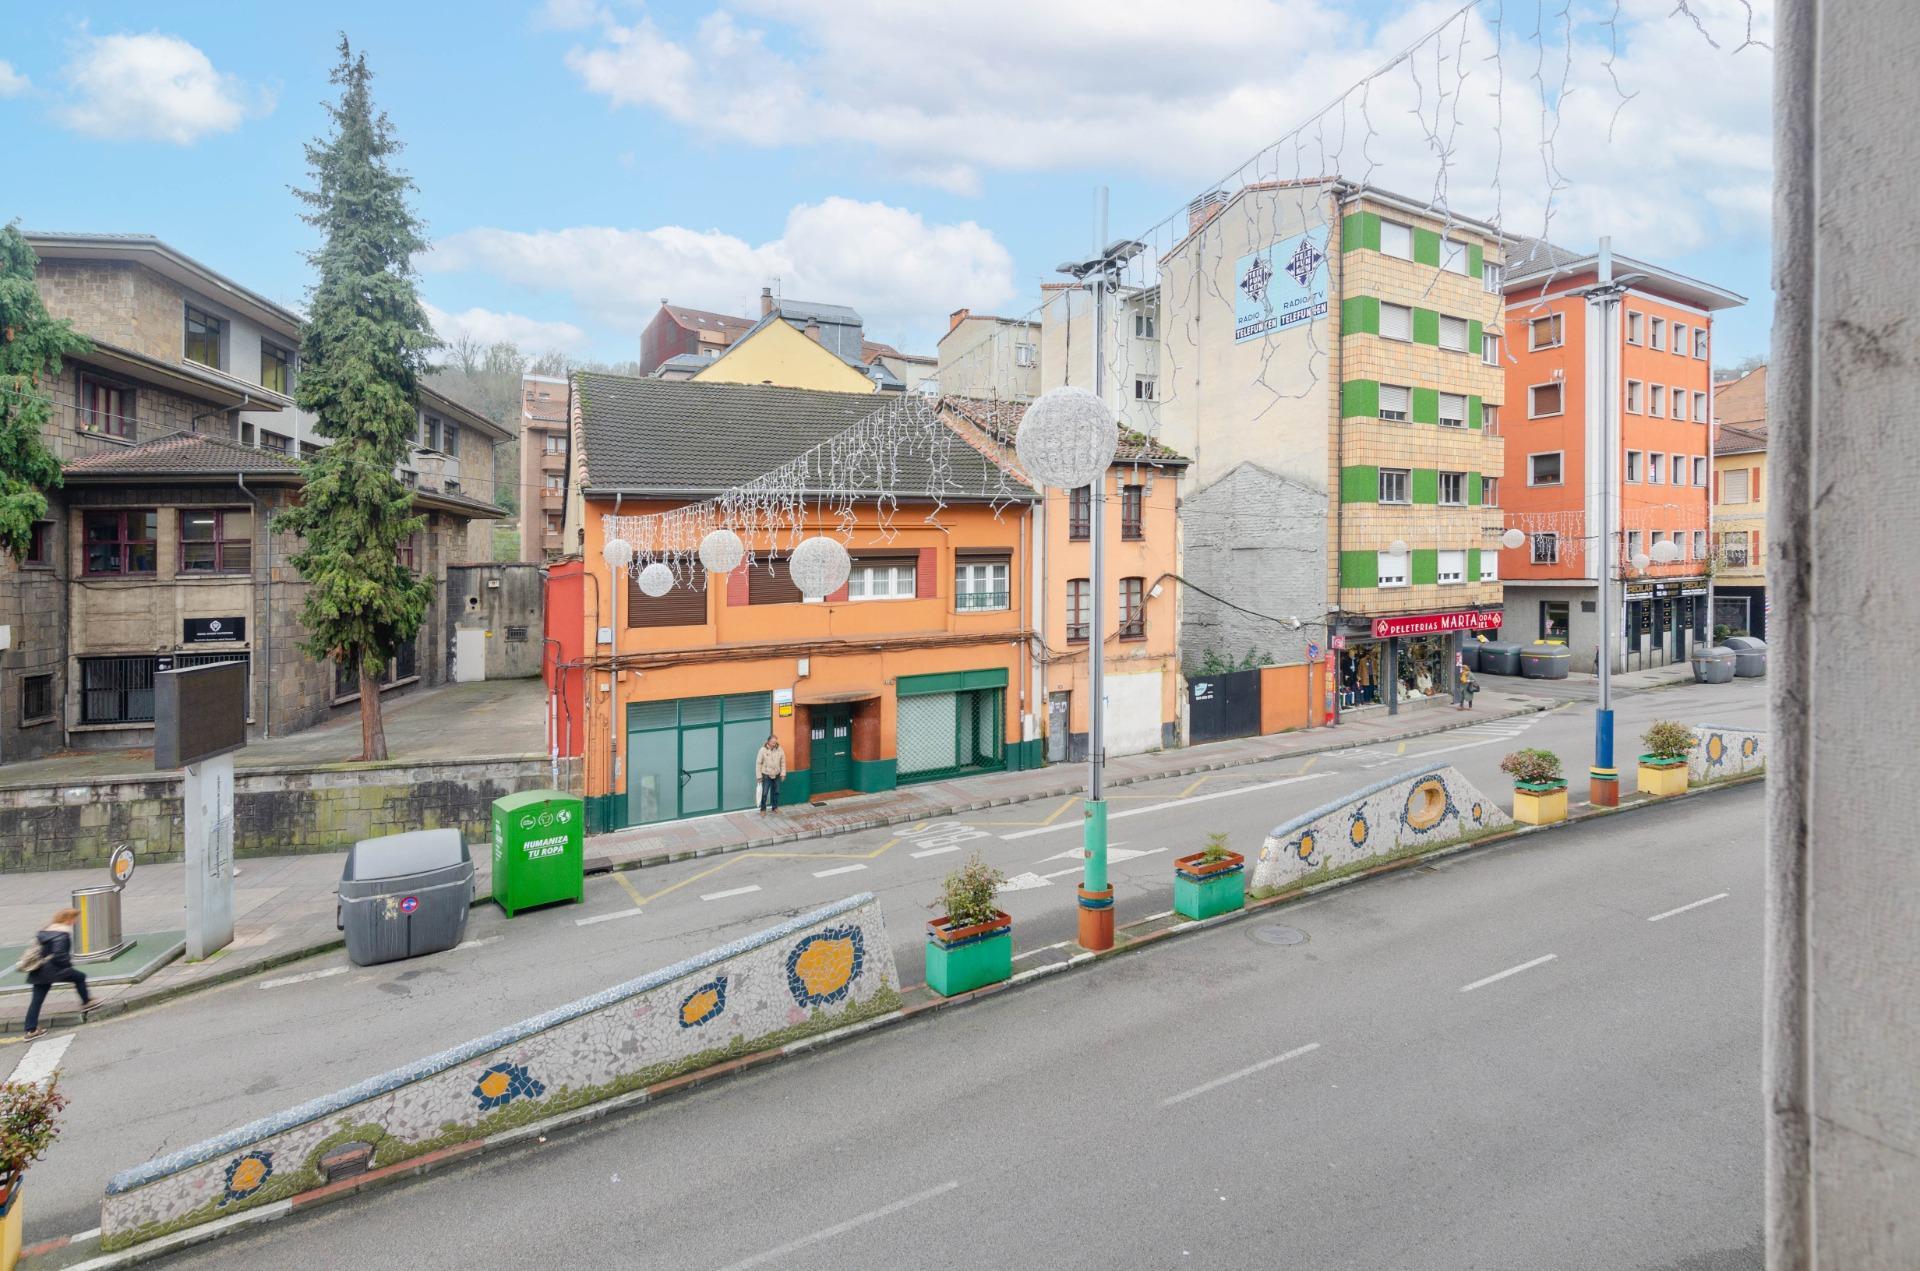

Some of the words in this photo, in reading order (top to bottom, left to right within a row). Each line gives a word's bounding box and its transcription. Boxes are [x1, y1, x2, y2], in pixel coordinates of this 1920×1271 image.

[1283, 296, 1308, 309] RADIO
[1238, 311, 1260, 324] RADIO
[1390, 622, 1438, 634] PELETERIAS
[1441, 613, 1478, 629] MARTA
[1478, 614, 1492, 622] ODA
[1478, 621, 1489, 629] IEL
[523, 835, 569, 850] HUMANIZA
[528, 848, 540, 858] TU
[542, 845, 564, 856] ROPA
